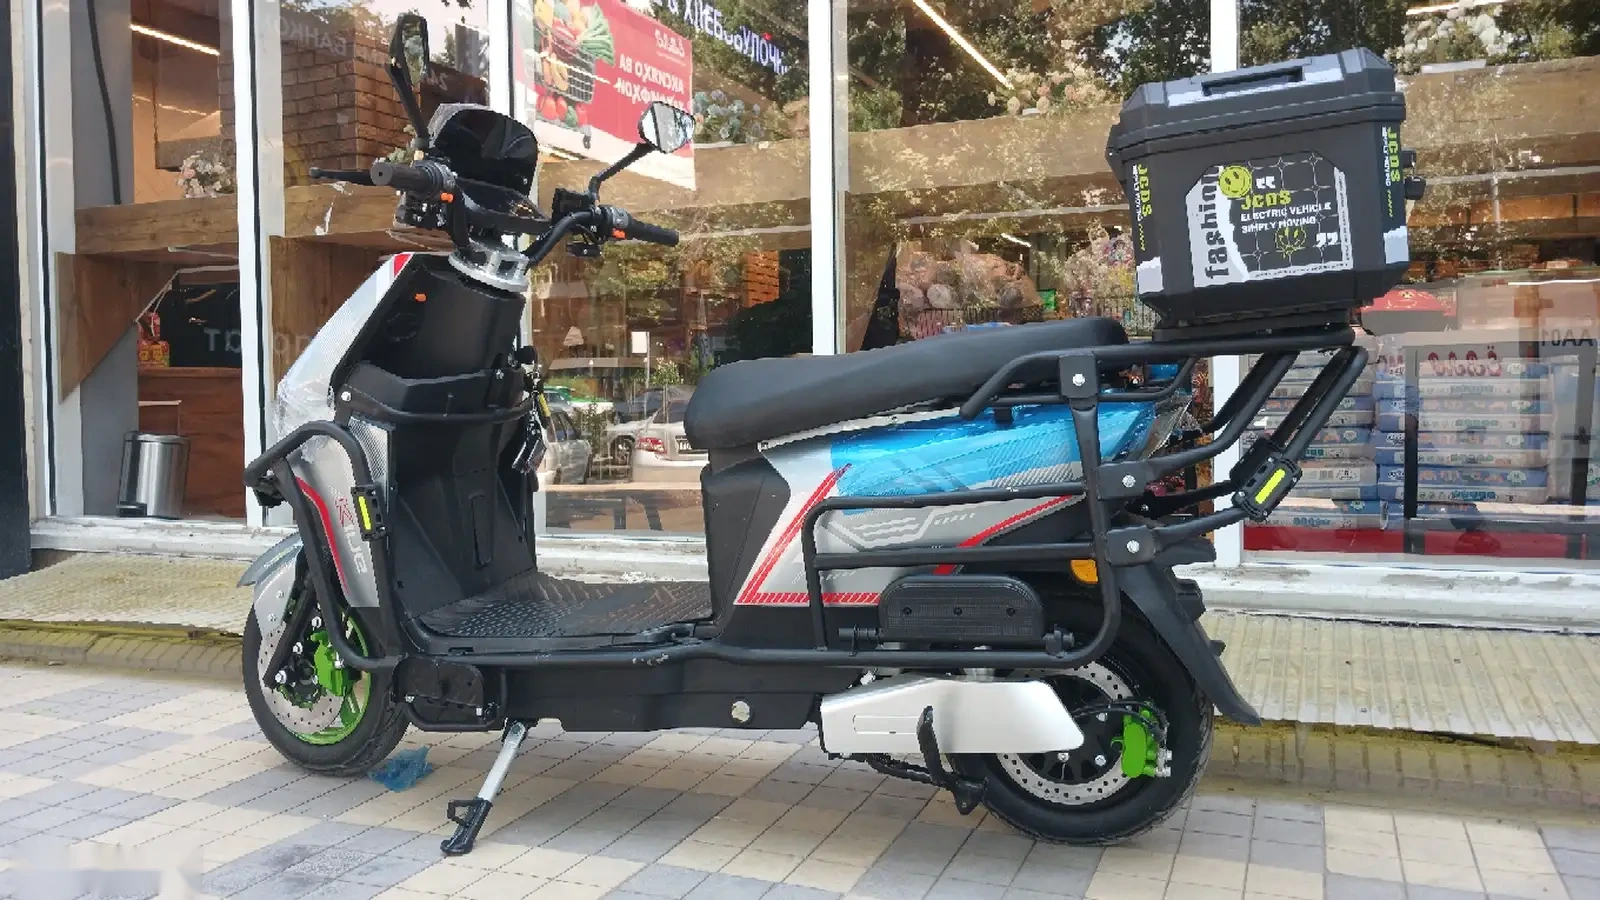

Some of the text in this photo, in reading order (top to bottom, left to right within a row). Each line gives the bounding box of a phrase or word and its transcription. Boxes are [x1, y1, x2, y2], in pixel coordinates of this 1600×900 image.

[1387, 127, 1401, 182] JCDS
[1137, 164, 1153, 217] JCDS
[1241, 190, 1292, 210] JCDS
[1240, 202, 1332, 222] ELECTRIC VEHICLE
[1241, 216, 1316, 234] SIMPLY MOVING
